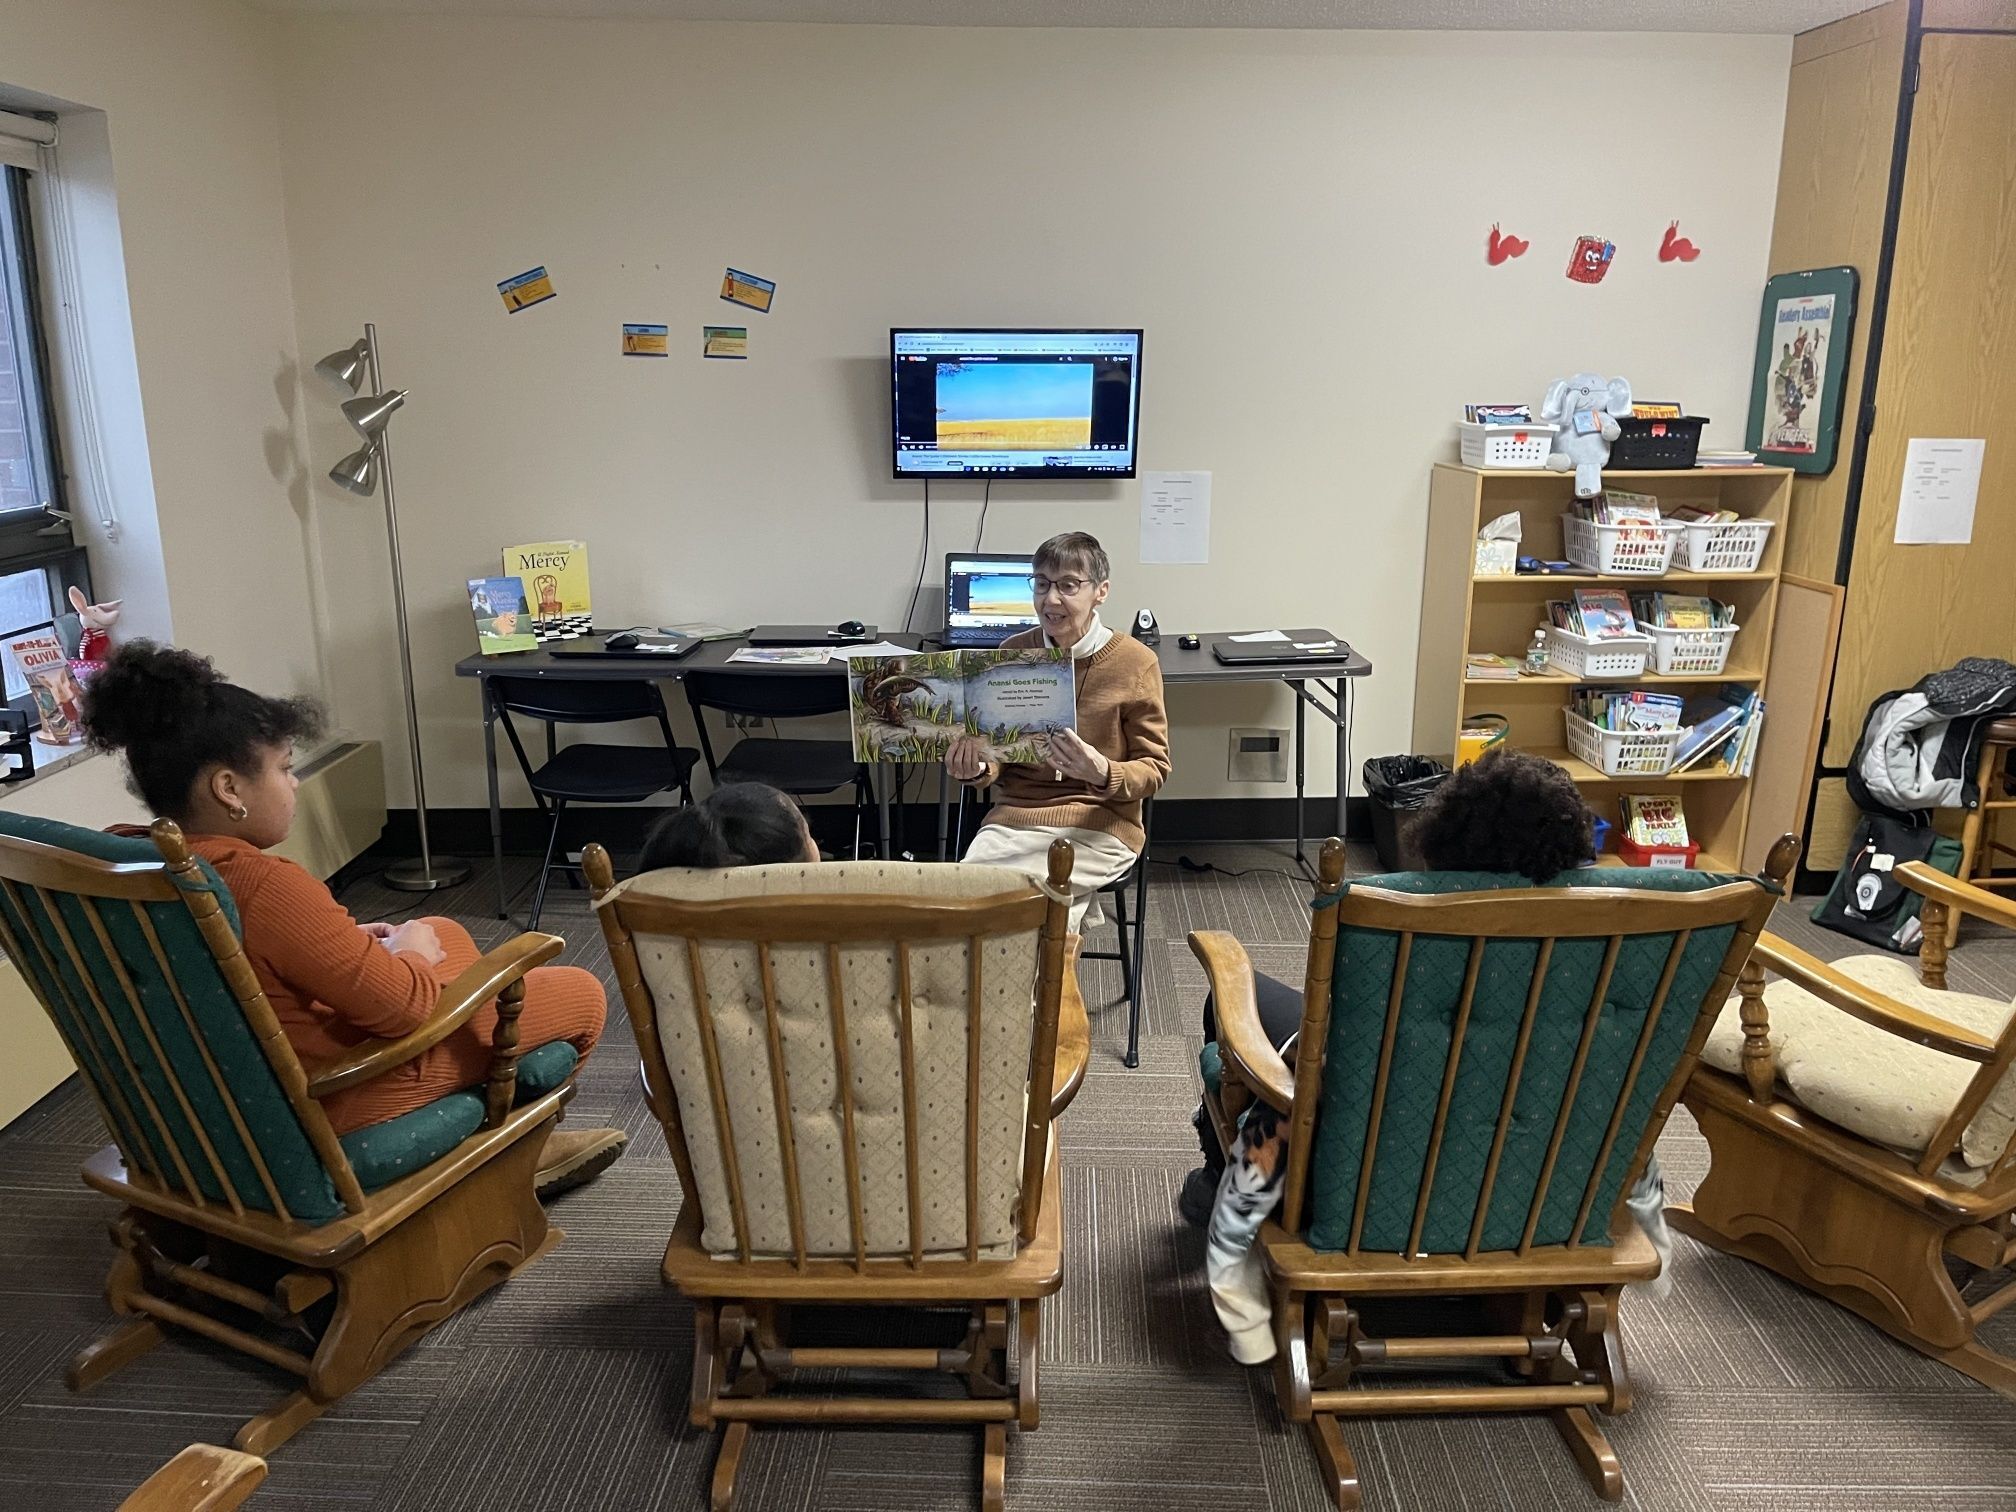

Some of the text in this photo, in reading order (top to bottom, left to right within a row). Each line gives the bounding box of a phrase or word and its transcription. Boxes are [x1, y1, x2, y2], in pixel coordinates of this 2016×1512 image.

[519, 553, 570, 572] Mercy
[24, 650, 61, 667] OLIVIA
[1032, 678, 1058, 687] Fishing
